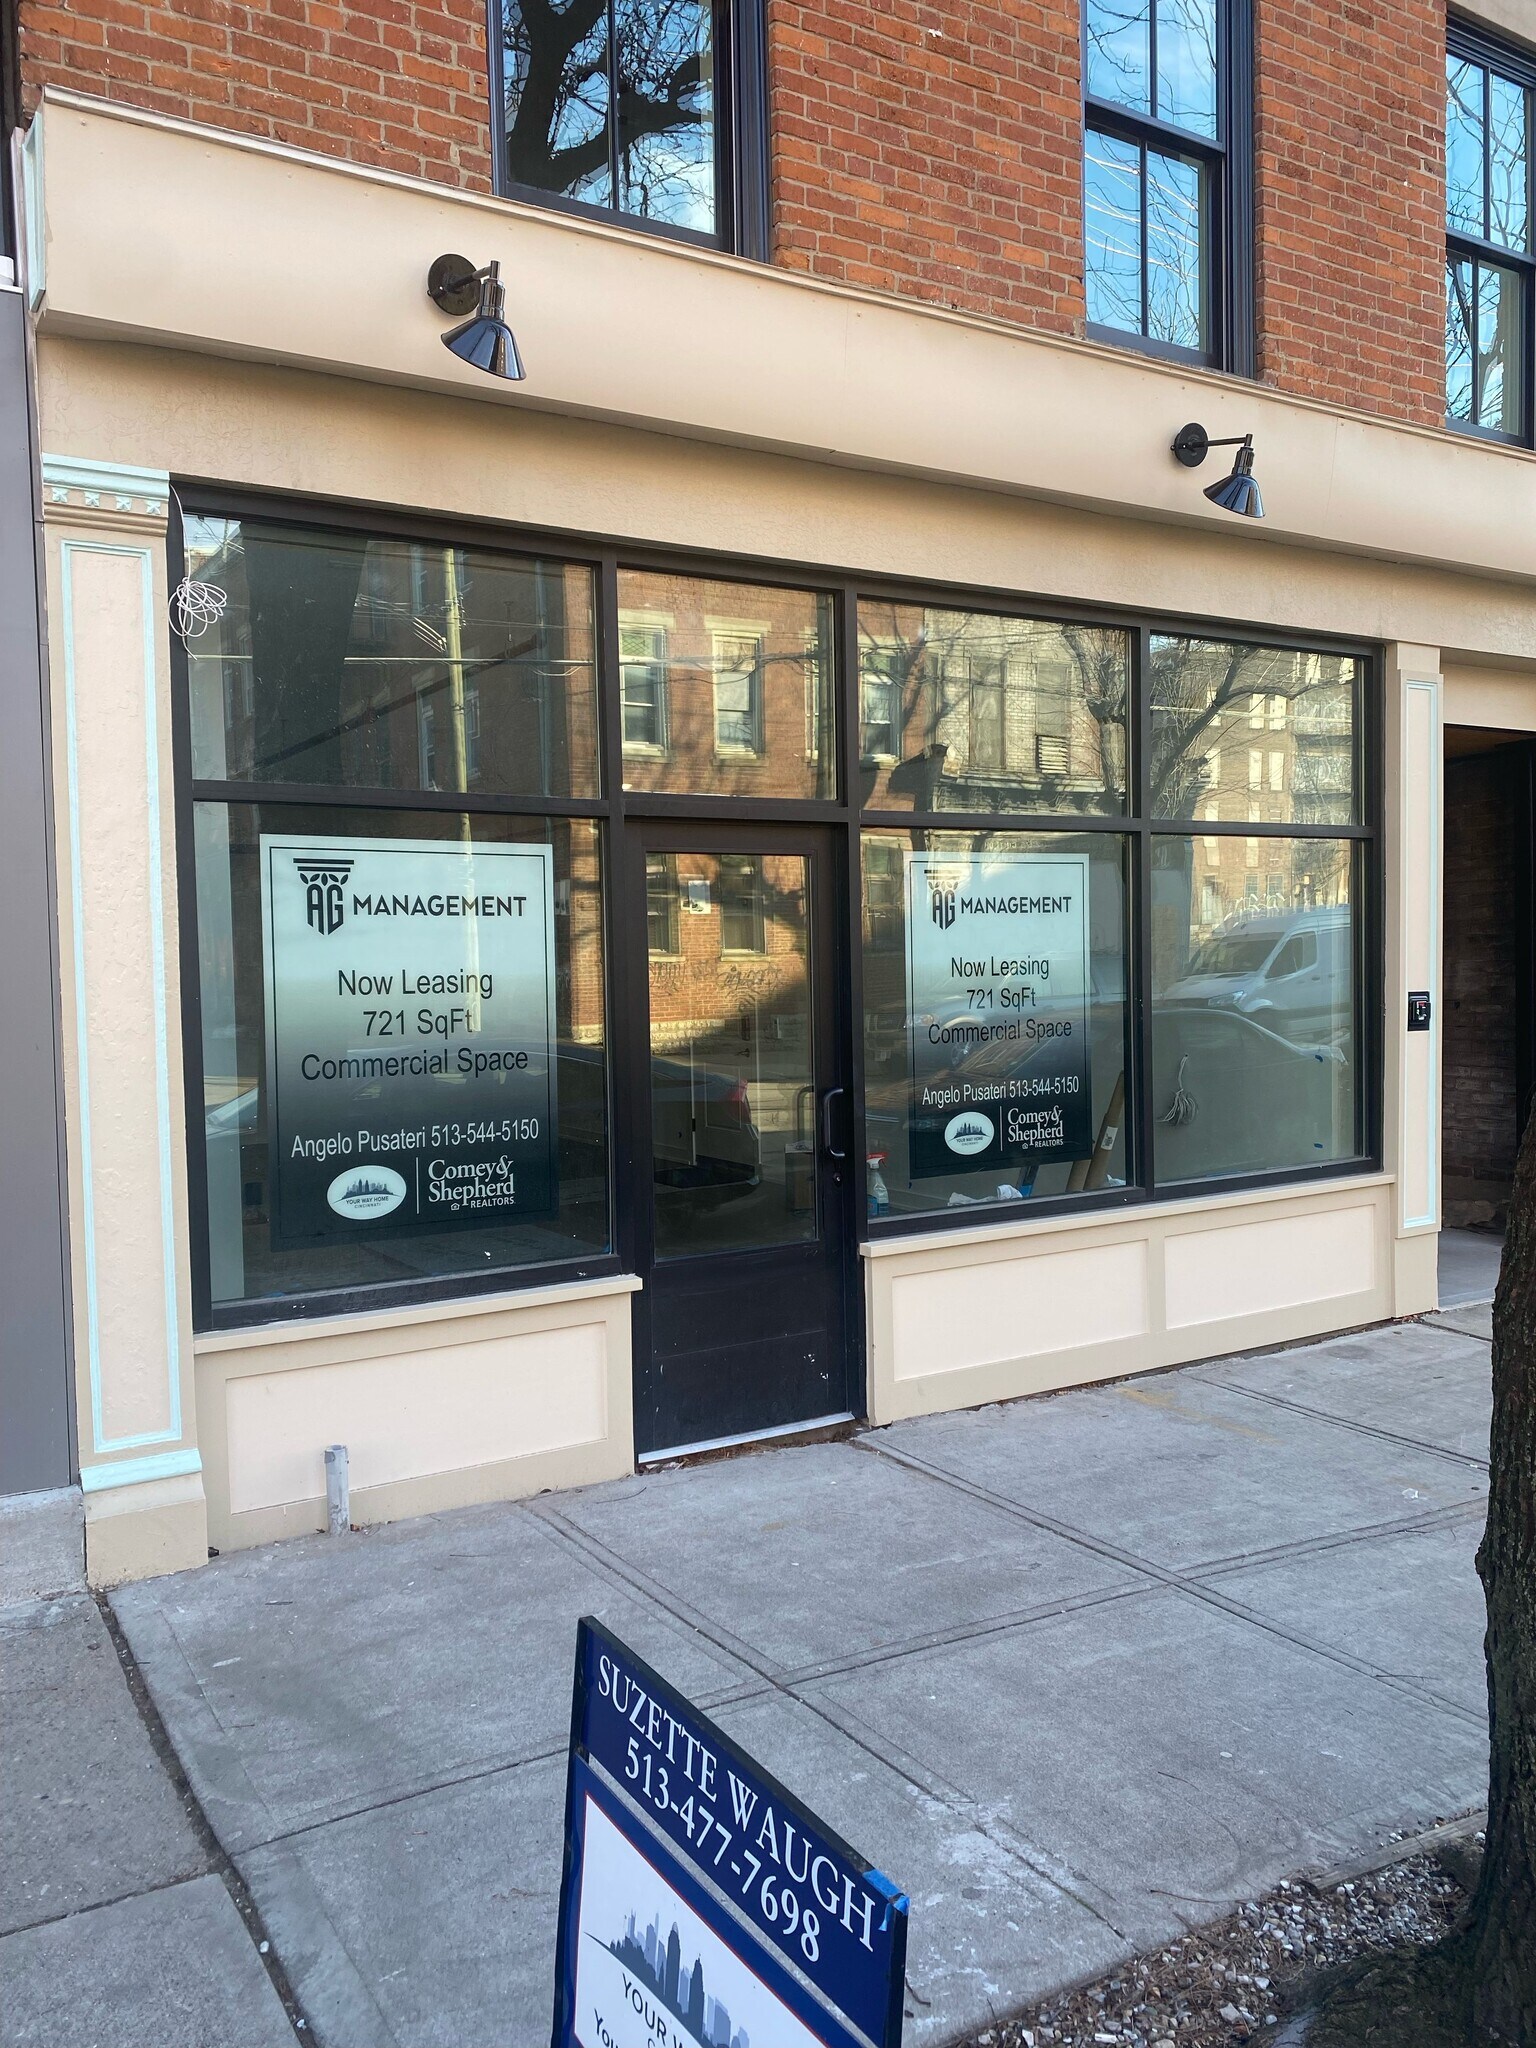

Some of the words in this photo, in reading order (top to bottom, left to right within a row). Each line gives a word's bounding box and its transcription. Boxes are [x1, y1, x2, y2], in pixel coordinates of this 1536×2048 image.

[307, 883, 344, 935] AG
[353, 894, 527, 917] MANAGEMENT
[961, 896, 1072, 914] MANAGEMENT
[338, 970, 393, 996] Now
[402, 968, 494, 999] Leasing
[951, 956, 985, 977] Now
[991, 956, 1049, 980] Leasing
[966, 989, 993, 1009] 721
[1000, 988, 1036, 1012] SqFt
[363, 1010, 405, 1036] 721
[417, 1008, 473, 1040] SqFt
[928, 1020, 1020, 1044] Commercial
[1026, 1019, 1072, 1043] Space
[301, 1049, 448, 1081] Commercial
[457, 1048, 529, 1078] Space
[922, 1086, 961, 1109] Angelo
[963, 1081, 1007, 1102] Pusateri
[1009, 1076, 1079, 1098] 513-544-5150
[291, 1132, 353, 1162] Angelo
[358, 1126, 426, 1152] Pusateri
[431, 1117, 539, 1147] 513-544-5150
[1008, 1120, 1064, 1146] Shepherd
[1035, 1139, 1064, 1148] REALTORS
[346, 1197, 361, 1205] YOUR
[428, 1174, 516, 1206] Shepherd
[470, 1196, 515, 1209] REALTORS
[598, 1654, 717, 1803] SUZETTE
[727, 1770, 875, 1952] WAUGH
[625, 1736, 821, 1963] 513-477-7698
[622, 1972, 667, 2047] YOUR
